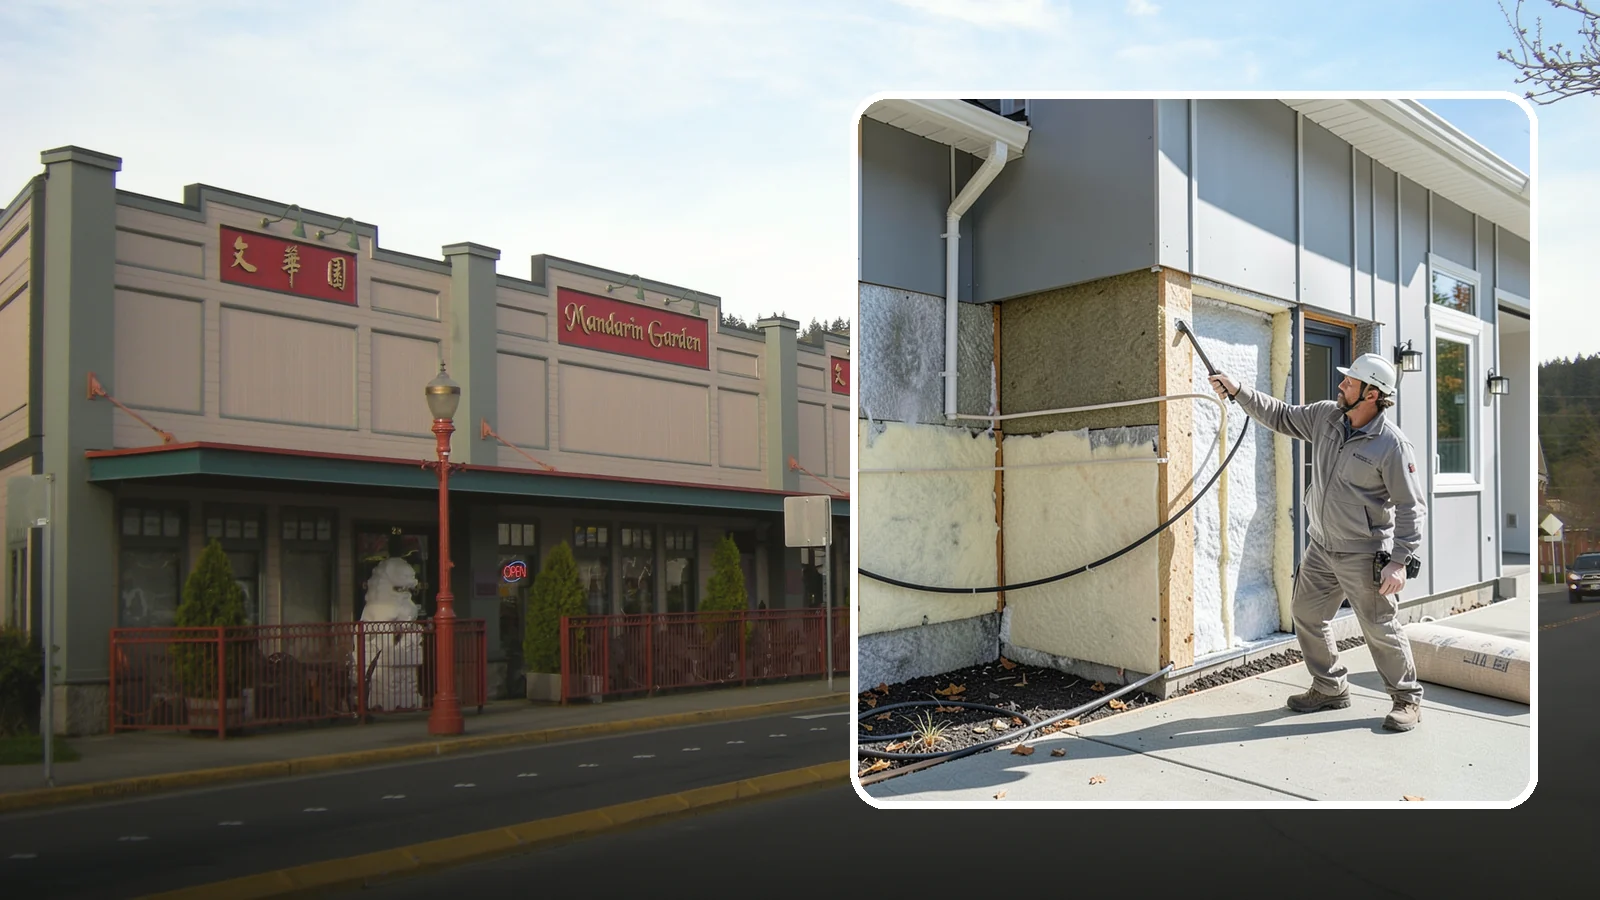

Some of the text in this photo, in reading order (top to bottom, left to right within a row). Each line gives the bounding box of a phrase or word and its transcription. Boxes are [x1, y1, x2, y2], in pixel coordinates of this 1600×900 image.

[231, 235, 346, 291] 文華園
[564, 302, 702, 352] Mandarin Garden
[503, 565, 527, 578] OPEN
